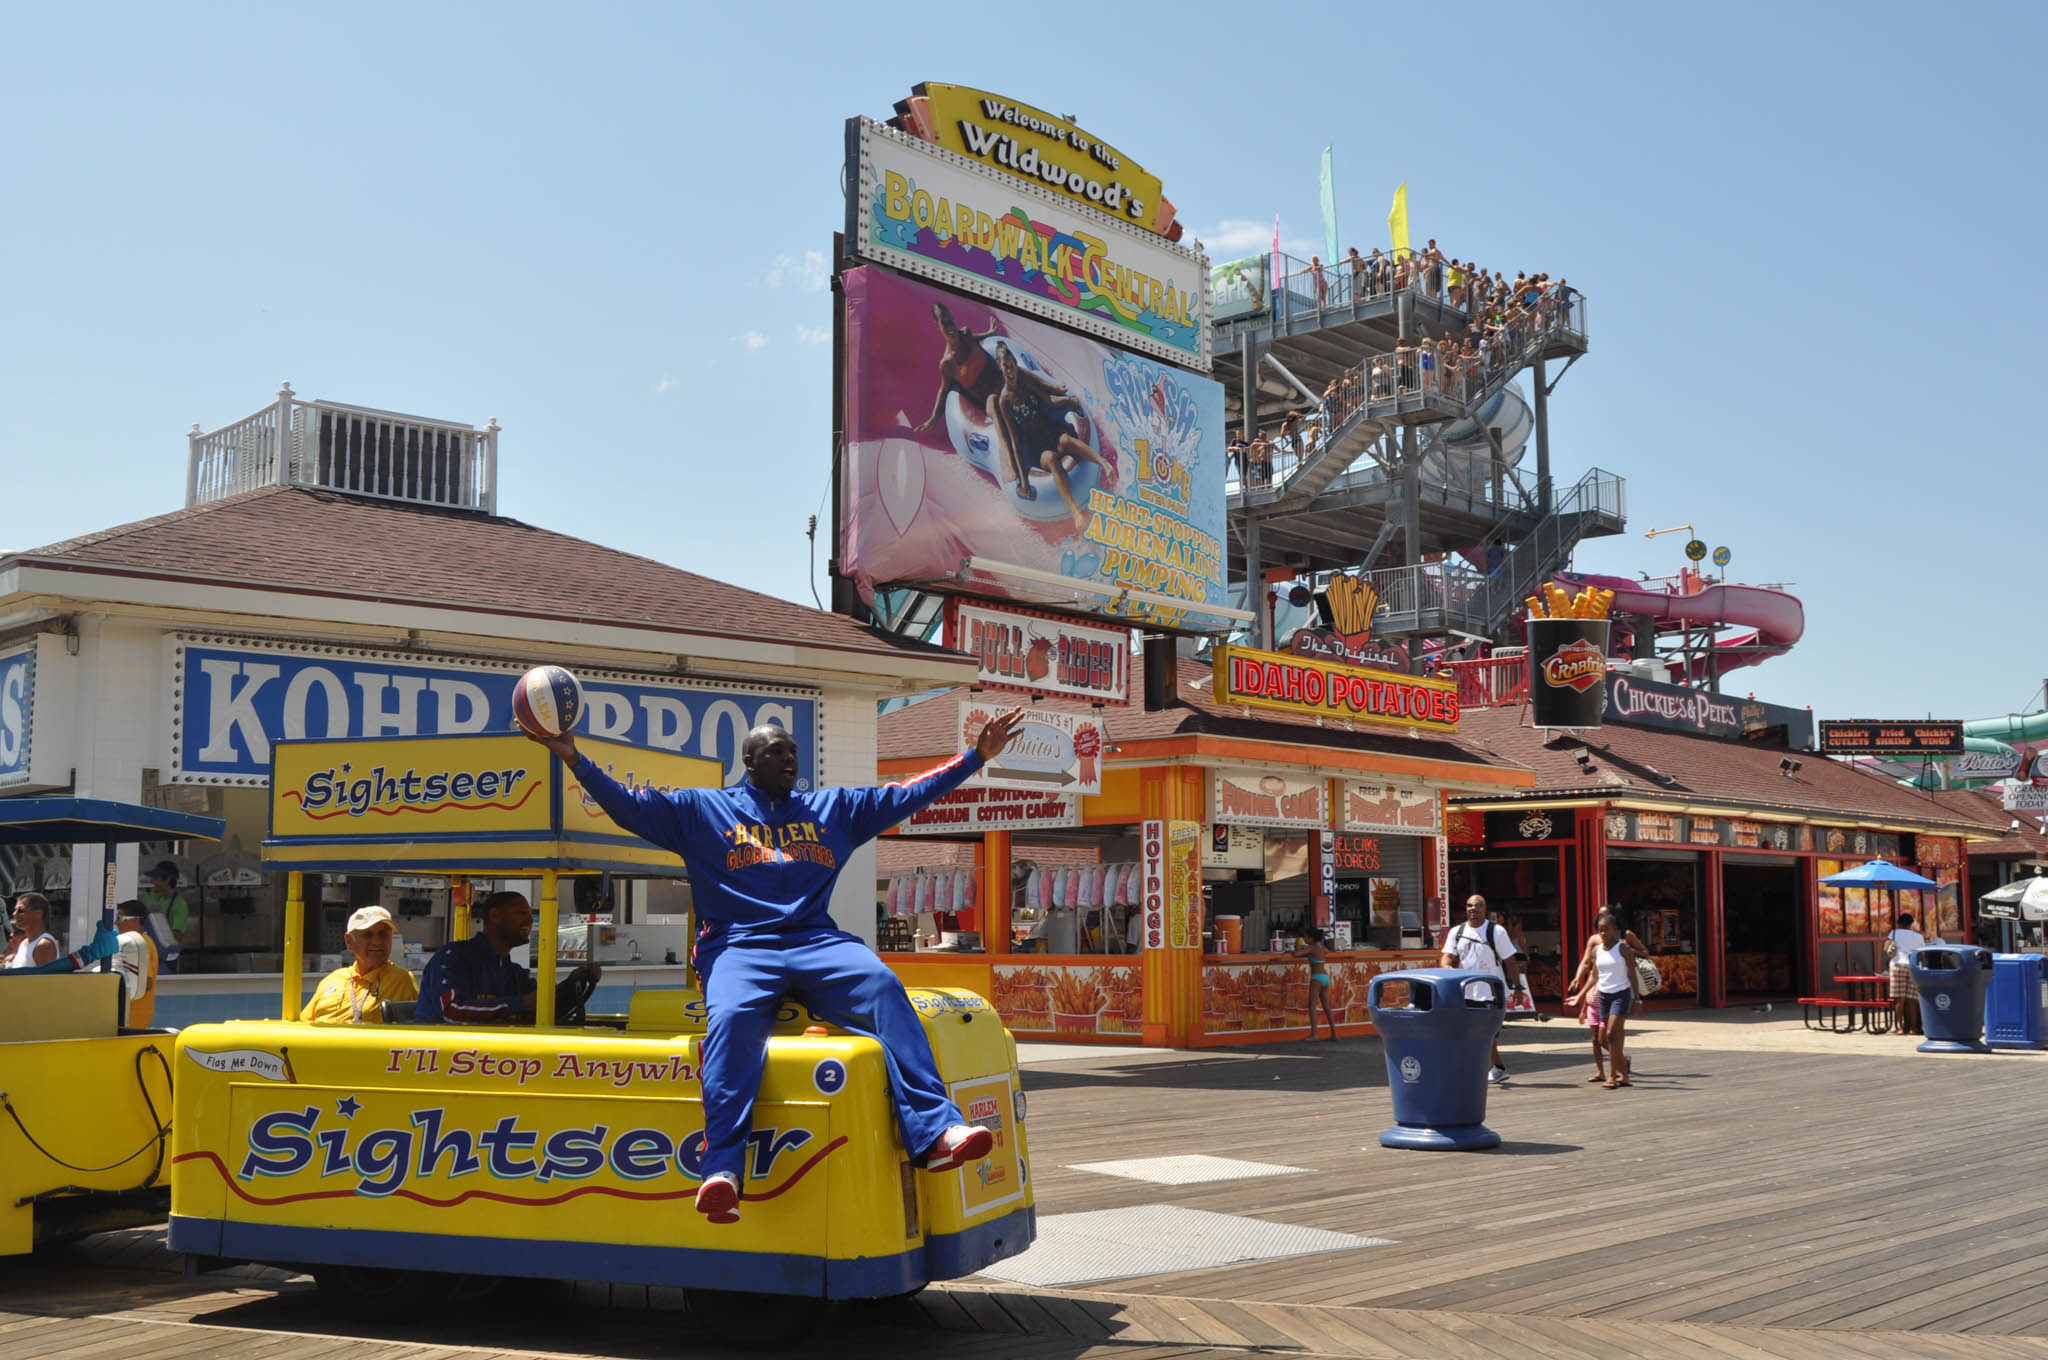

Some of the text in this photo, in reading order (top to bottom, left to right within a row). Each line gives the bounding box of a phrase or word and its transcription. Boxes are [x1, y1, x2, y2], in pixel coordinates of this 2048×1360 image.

[981, 98, 1120, 171] Welcome to the
[958, 120, 1144, 219] Wildwood's
[1090, 489, 1221, 559] HEART-STOPPING
[1085, 513, 1222, 586] ADRENALINE
[1103, 549, 1207, 603] PUMPING
[1301, 635, 1398, 665] The Original
[1229, 656, 1459, 724] IDAHO POTATOES
[1026, 711, 1061, 727] PHILLY'S
[1829, 737, 1869, 746] CUTLETS
[1880, 729, 1904, 737] Fried
[1920, 737, 1950, 746] WINGS
[302, 763, 527, 818] Sightseer
[1359, 786, 1413, 799] FRESH CUT
[910, 802, 1066, 825] LEMONADE COTTON CANDY
[2015, 801, 2045, 809] TODAY
[735, 822, 819, 849] HARLEM
[1344, 853, 1380, 870] OREOS
[206, 1056, 277, 1072] Flag Me Down
[386, 1048, 439, 1073] I'll
[448, 1050, 542, 1084] Stop
[824, 1070, 836, 1082] 2
[968, 1100, 999, 1120] HARLEM
